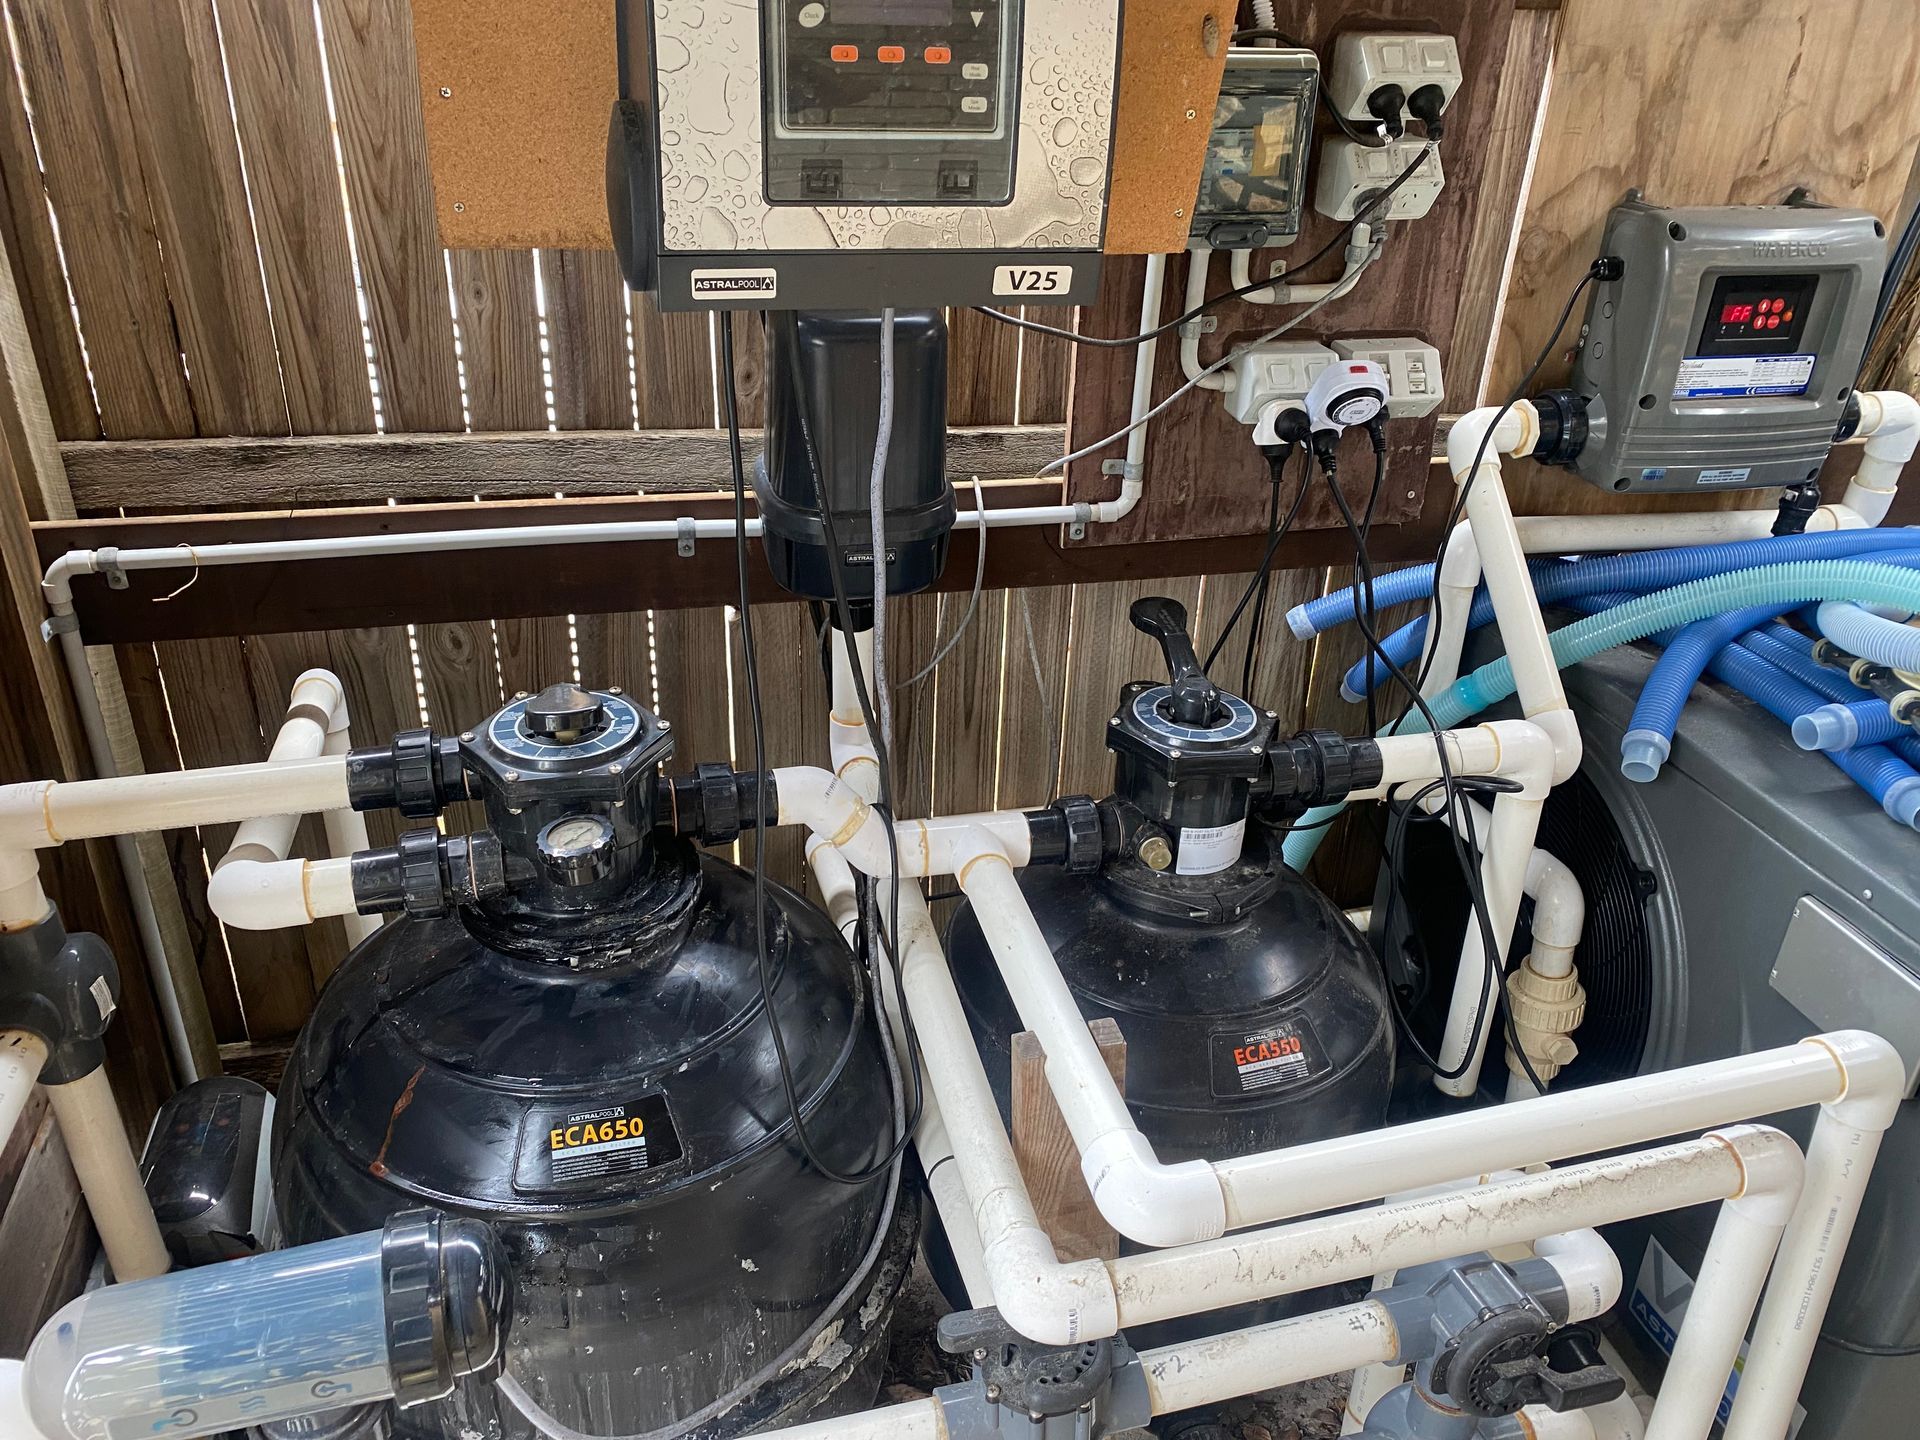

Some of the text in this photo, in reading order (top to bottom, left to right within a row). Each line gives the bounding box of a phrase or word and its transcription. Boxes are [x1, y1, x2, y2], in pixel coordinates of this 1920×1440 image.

[1753, 241, 1828, 258] WATERCO
[695, 279, 760, 289] ASTRALPOOL
[1009, 270, 1058, 291] V25
[1233, 1036, 1301, 1066] ECA550
[570, 1110, 614, 1122] ASTRALPOOL
[550, 1117, 644, 1149] ECA650
[1376, 1194, 1465, 1217] PIPEMAKERS
[1637, 1303, 1675, 1345] AST
